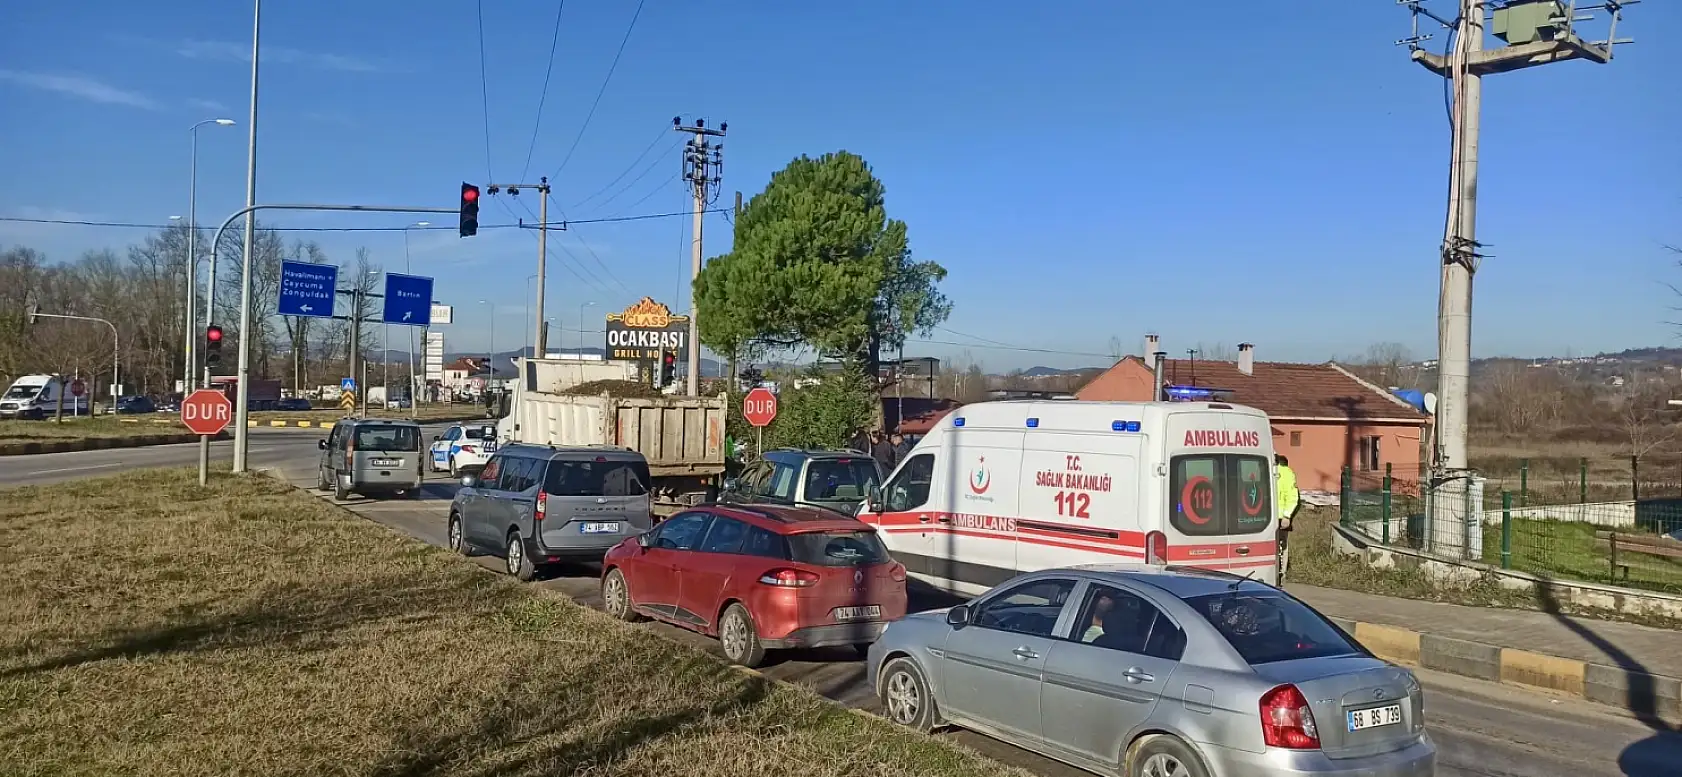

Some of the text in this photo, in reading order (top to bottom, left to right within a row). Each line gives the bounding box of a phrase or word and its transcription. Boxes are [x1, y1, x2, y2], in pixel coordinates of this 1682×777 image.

[282, 288, 330, 299] Zonguldak
[625, 315, 667, 326] CLASS
[614, 349, 641, 358] GRILL
[186, 402, 228, 420] DUR
[747, 400, 774, 414] DUR
[1183, 430, 1260, 447] AMBULANS
[1066, 455, 1082, 471] T.C.
[1036, 469, 1112, 492] SAĞLIK BAKANLIĞI
[1054, 491, 1091, 519] 112
[1194, 489, 1214, 509] 112
[951, 512, 1017, 532] AMBULANS
[1354, 706, 1400, 728] 68 BS 739
